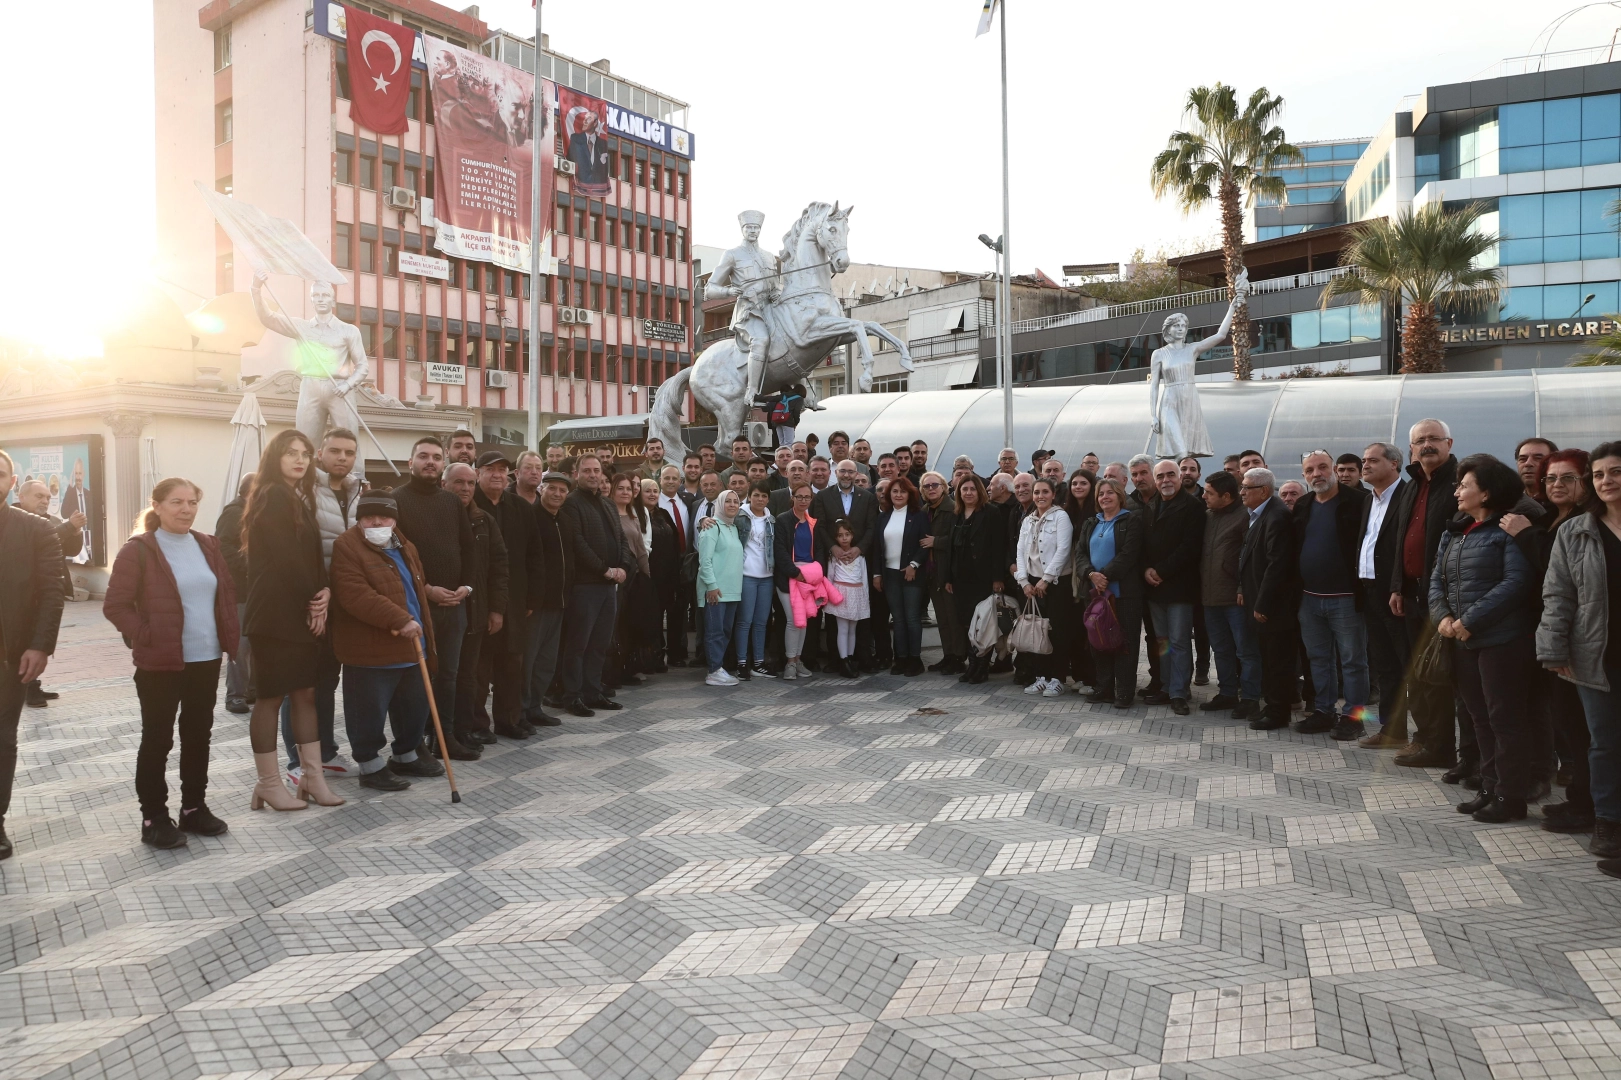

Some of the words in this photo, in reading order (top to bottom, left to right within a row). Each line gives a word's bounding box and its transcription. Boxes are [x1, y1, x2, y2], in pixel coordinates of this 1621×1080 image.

[606, 104, 666, 146] KANLIĞI
[461, 173, 492, 186] TÜRKİYE
[461, 189, 480, 200] EMİN
[460, 232, 491, 244] AKPARTİ
[464, 241, 479, 252] İLÇE
[1439, 325, 1530, 343] MENEMEN
[432, 364, 461, 372] AVUKAT
